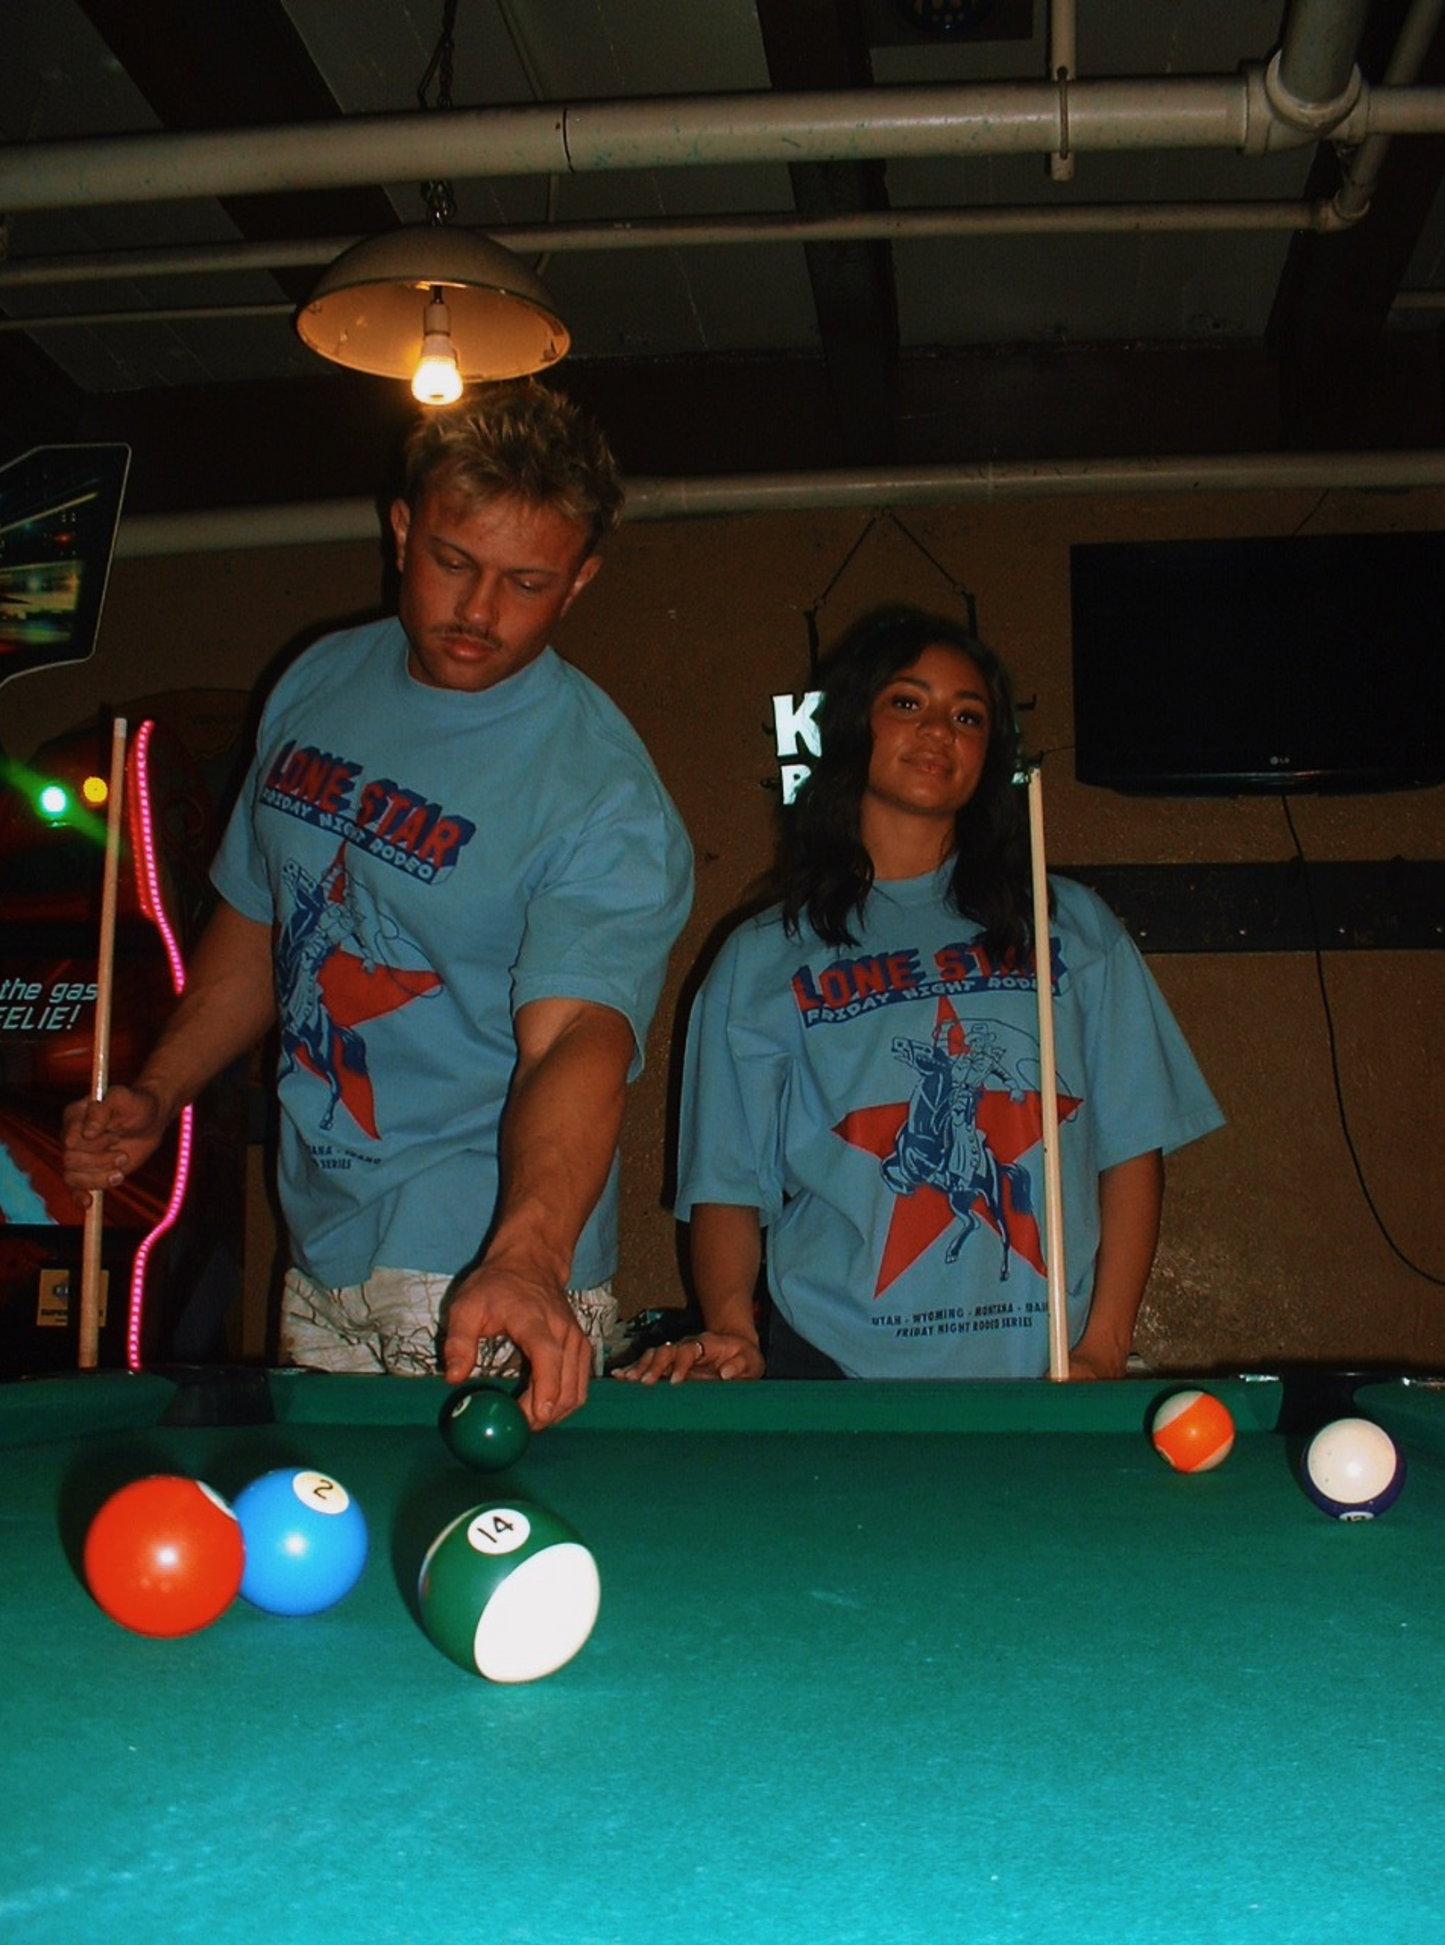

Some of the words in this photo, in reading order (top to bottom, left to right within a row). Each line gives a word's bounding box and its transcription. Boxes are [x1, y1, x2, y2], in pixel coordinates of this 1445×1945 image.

[264, 739, 363, 814] LONE
[355, 778, 477, 870] STAR
[369, 837, 434, 880] RODEO
[0, 978, 43, 1000] the
[49, 983, 98, 1003] gas
[791, 948, 926, 1012] LONE
[805, 991, 891, 1026] FRIDAY
[903, 979, 976, 998] NIGHT
[871, 1315, 902, 1327] UTAH
[912, 1308, 965, 1324] WYOMING
[974, 1302, 1014, 1318] MONTANA
[895, 1326, 934, 1339] FRIDAY
[937, 1321, 970, 1335] NIGHT
[972, 1319, 1000, 1333] RODEO
[1002, 1316, 1033, 1329] SERIES
[313, 1479, 334, 1500] 2
[477, 1515, 514, 1544] 14
